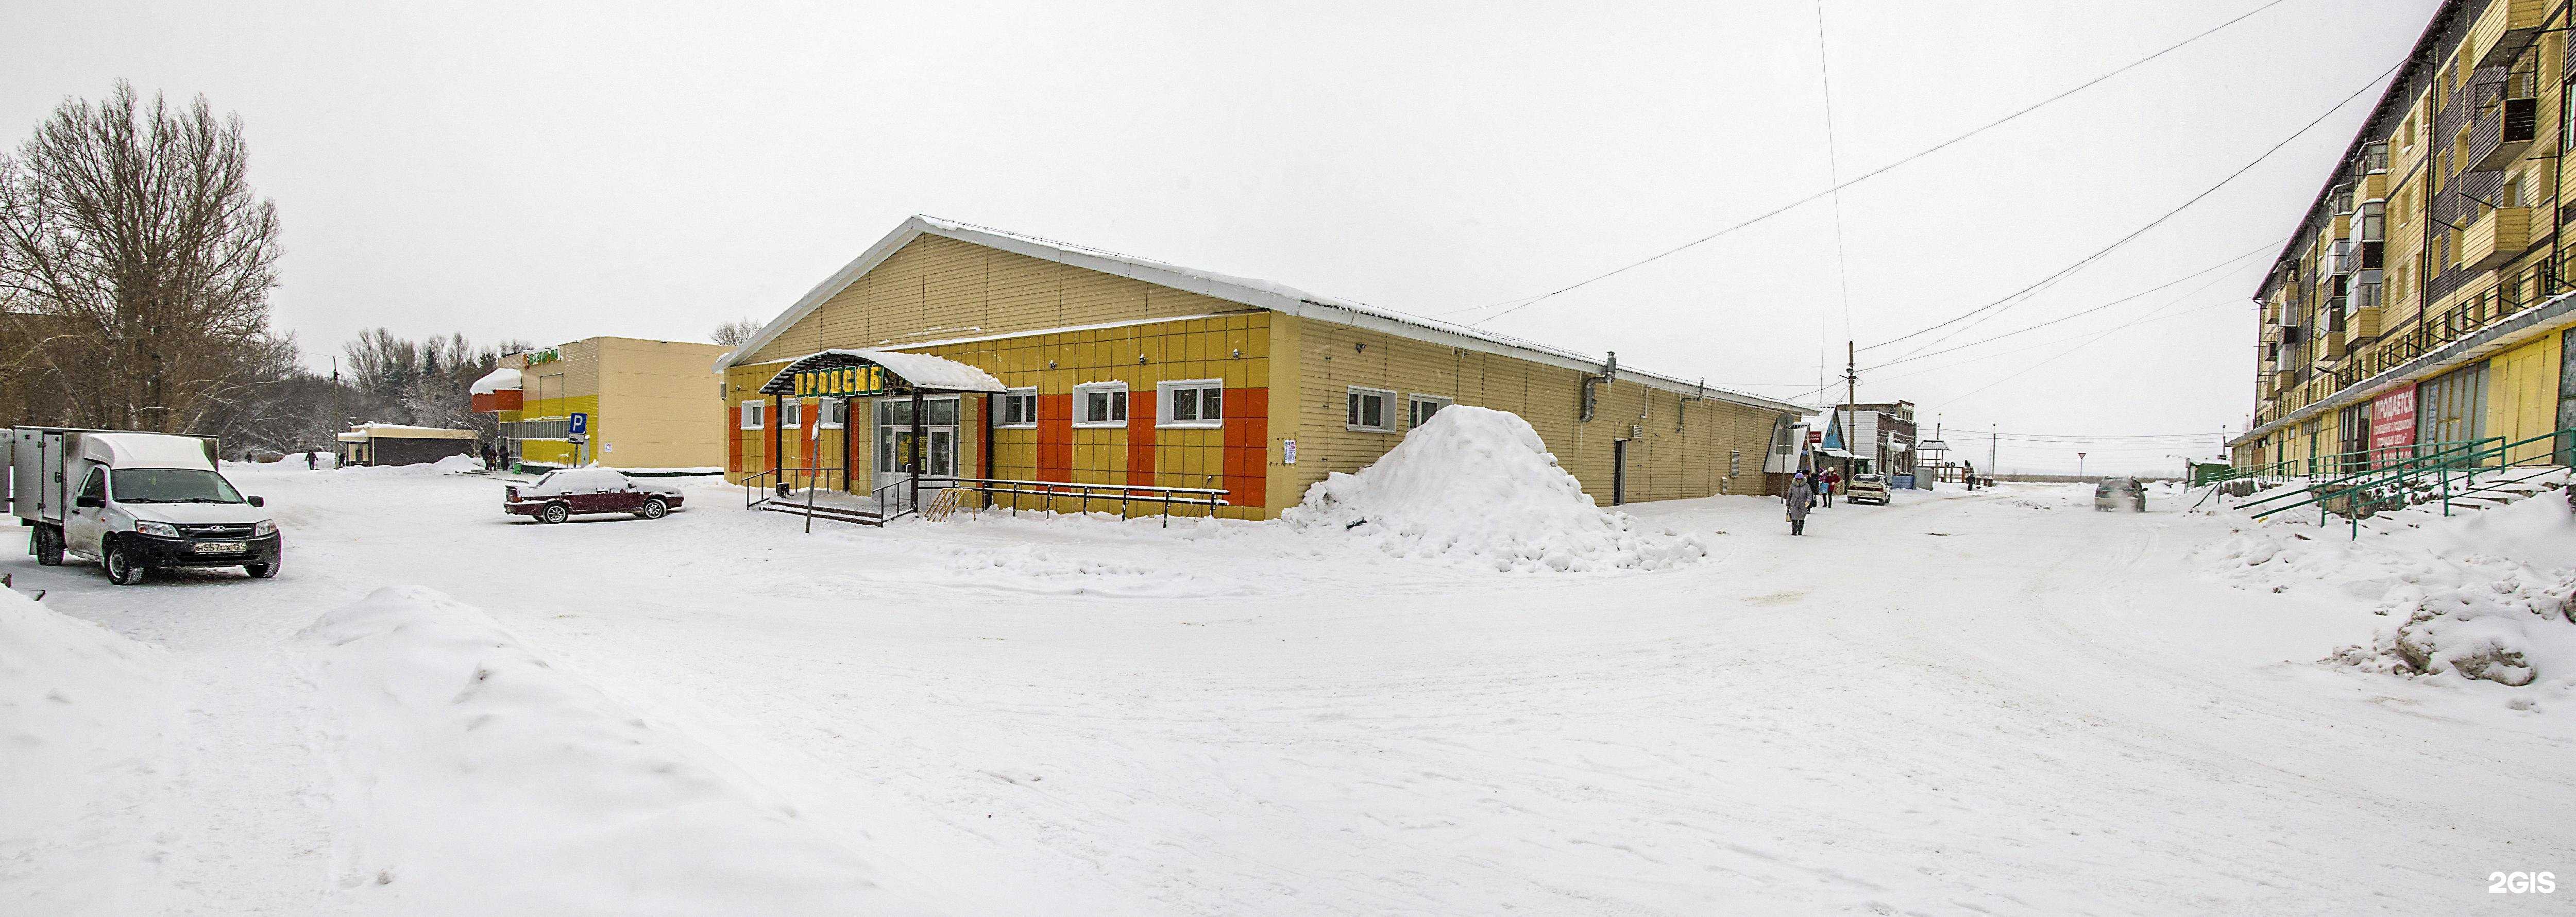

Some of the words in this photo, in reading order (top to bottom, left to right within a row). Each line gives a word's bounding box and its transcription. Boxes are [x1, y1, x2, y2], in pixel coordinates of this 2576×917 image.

[795, 365, 882, 395] ПРОДСИБ
[2374, 390, 2413, 421] ПРОДАЕТСЯ
[573, 415, 583, 431] P
